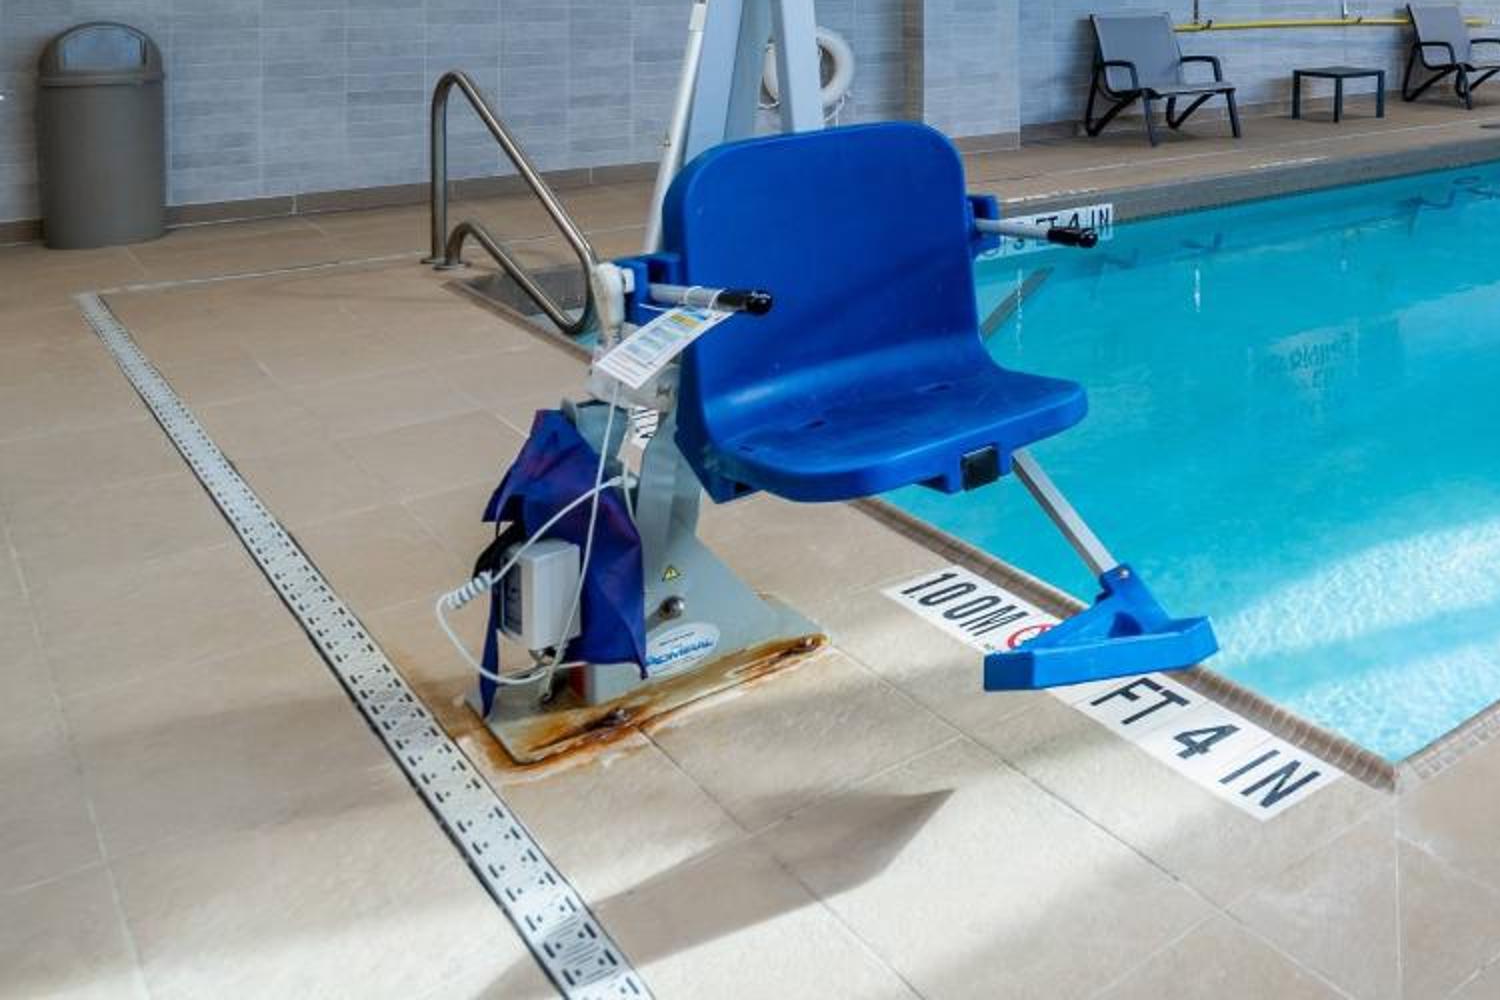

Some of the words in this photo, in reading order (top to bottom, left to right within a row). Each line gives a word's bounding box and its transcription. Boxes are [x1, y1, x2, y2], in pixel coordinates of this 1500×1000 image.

[1090, 677, 1190, 725] FT
[1173, 724, 1241, 760] 4
[1218, 750, 1321, 808] IN
